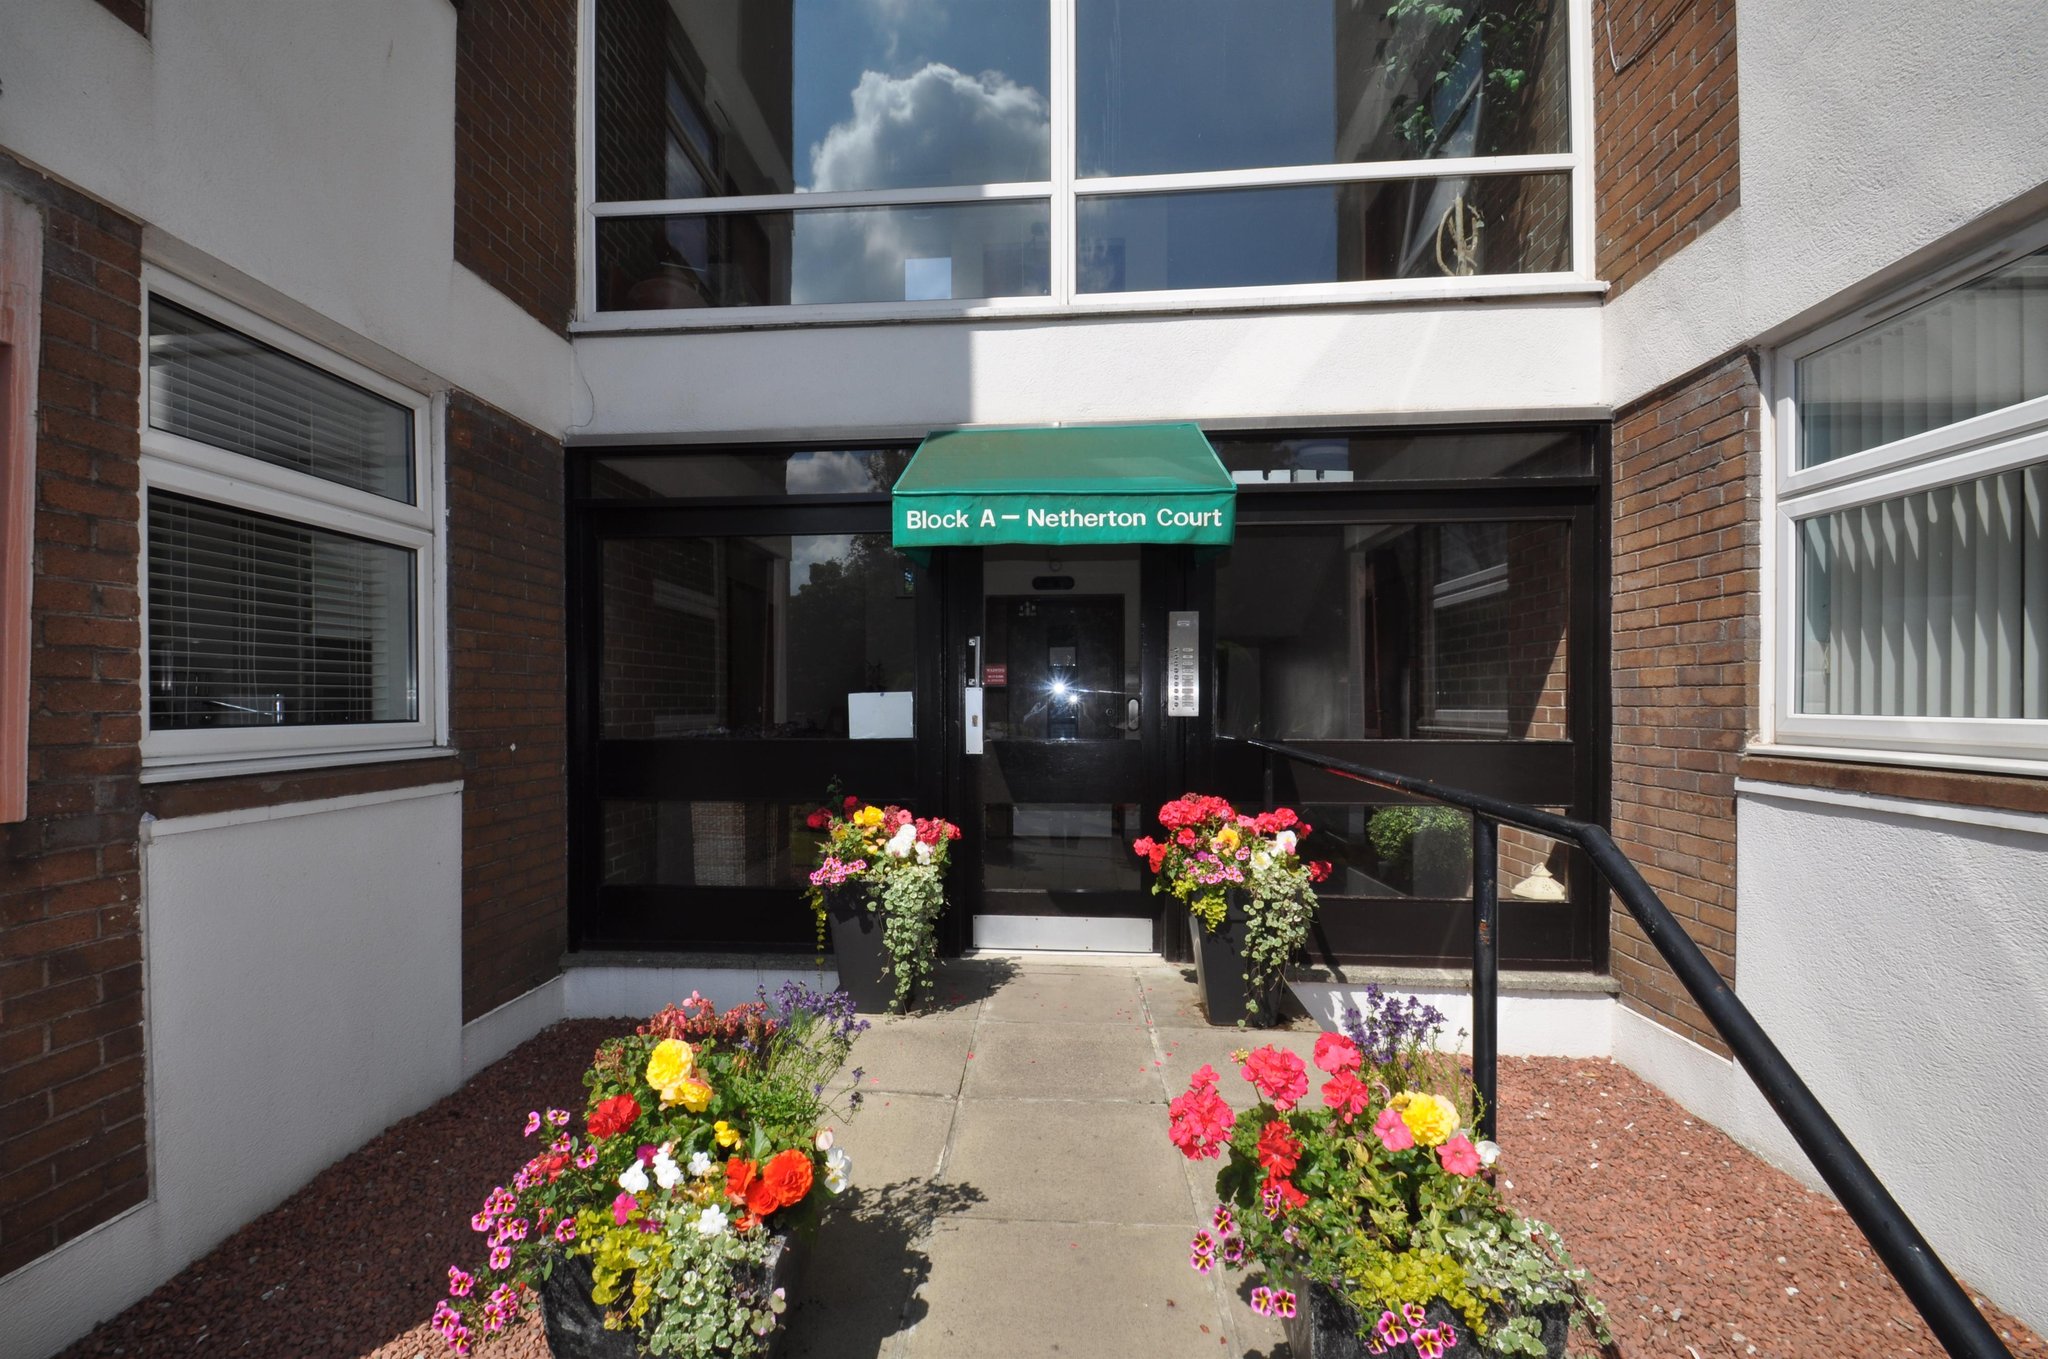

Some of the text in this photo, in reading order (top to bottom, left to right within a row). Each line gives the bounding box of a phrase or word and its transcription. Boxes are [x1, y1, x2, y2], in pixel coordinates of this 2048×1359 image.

[906, 508, 969, 530] Block
[979, 508, 996, 528] A
[1027, 508, 1147, 528] Netherton
[1156, 508, 1222, 528] Court
